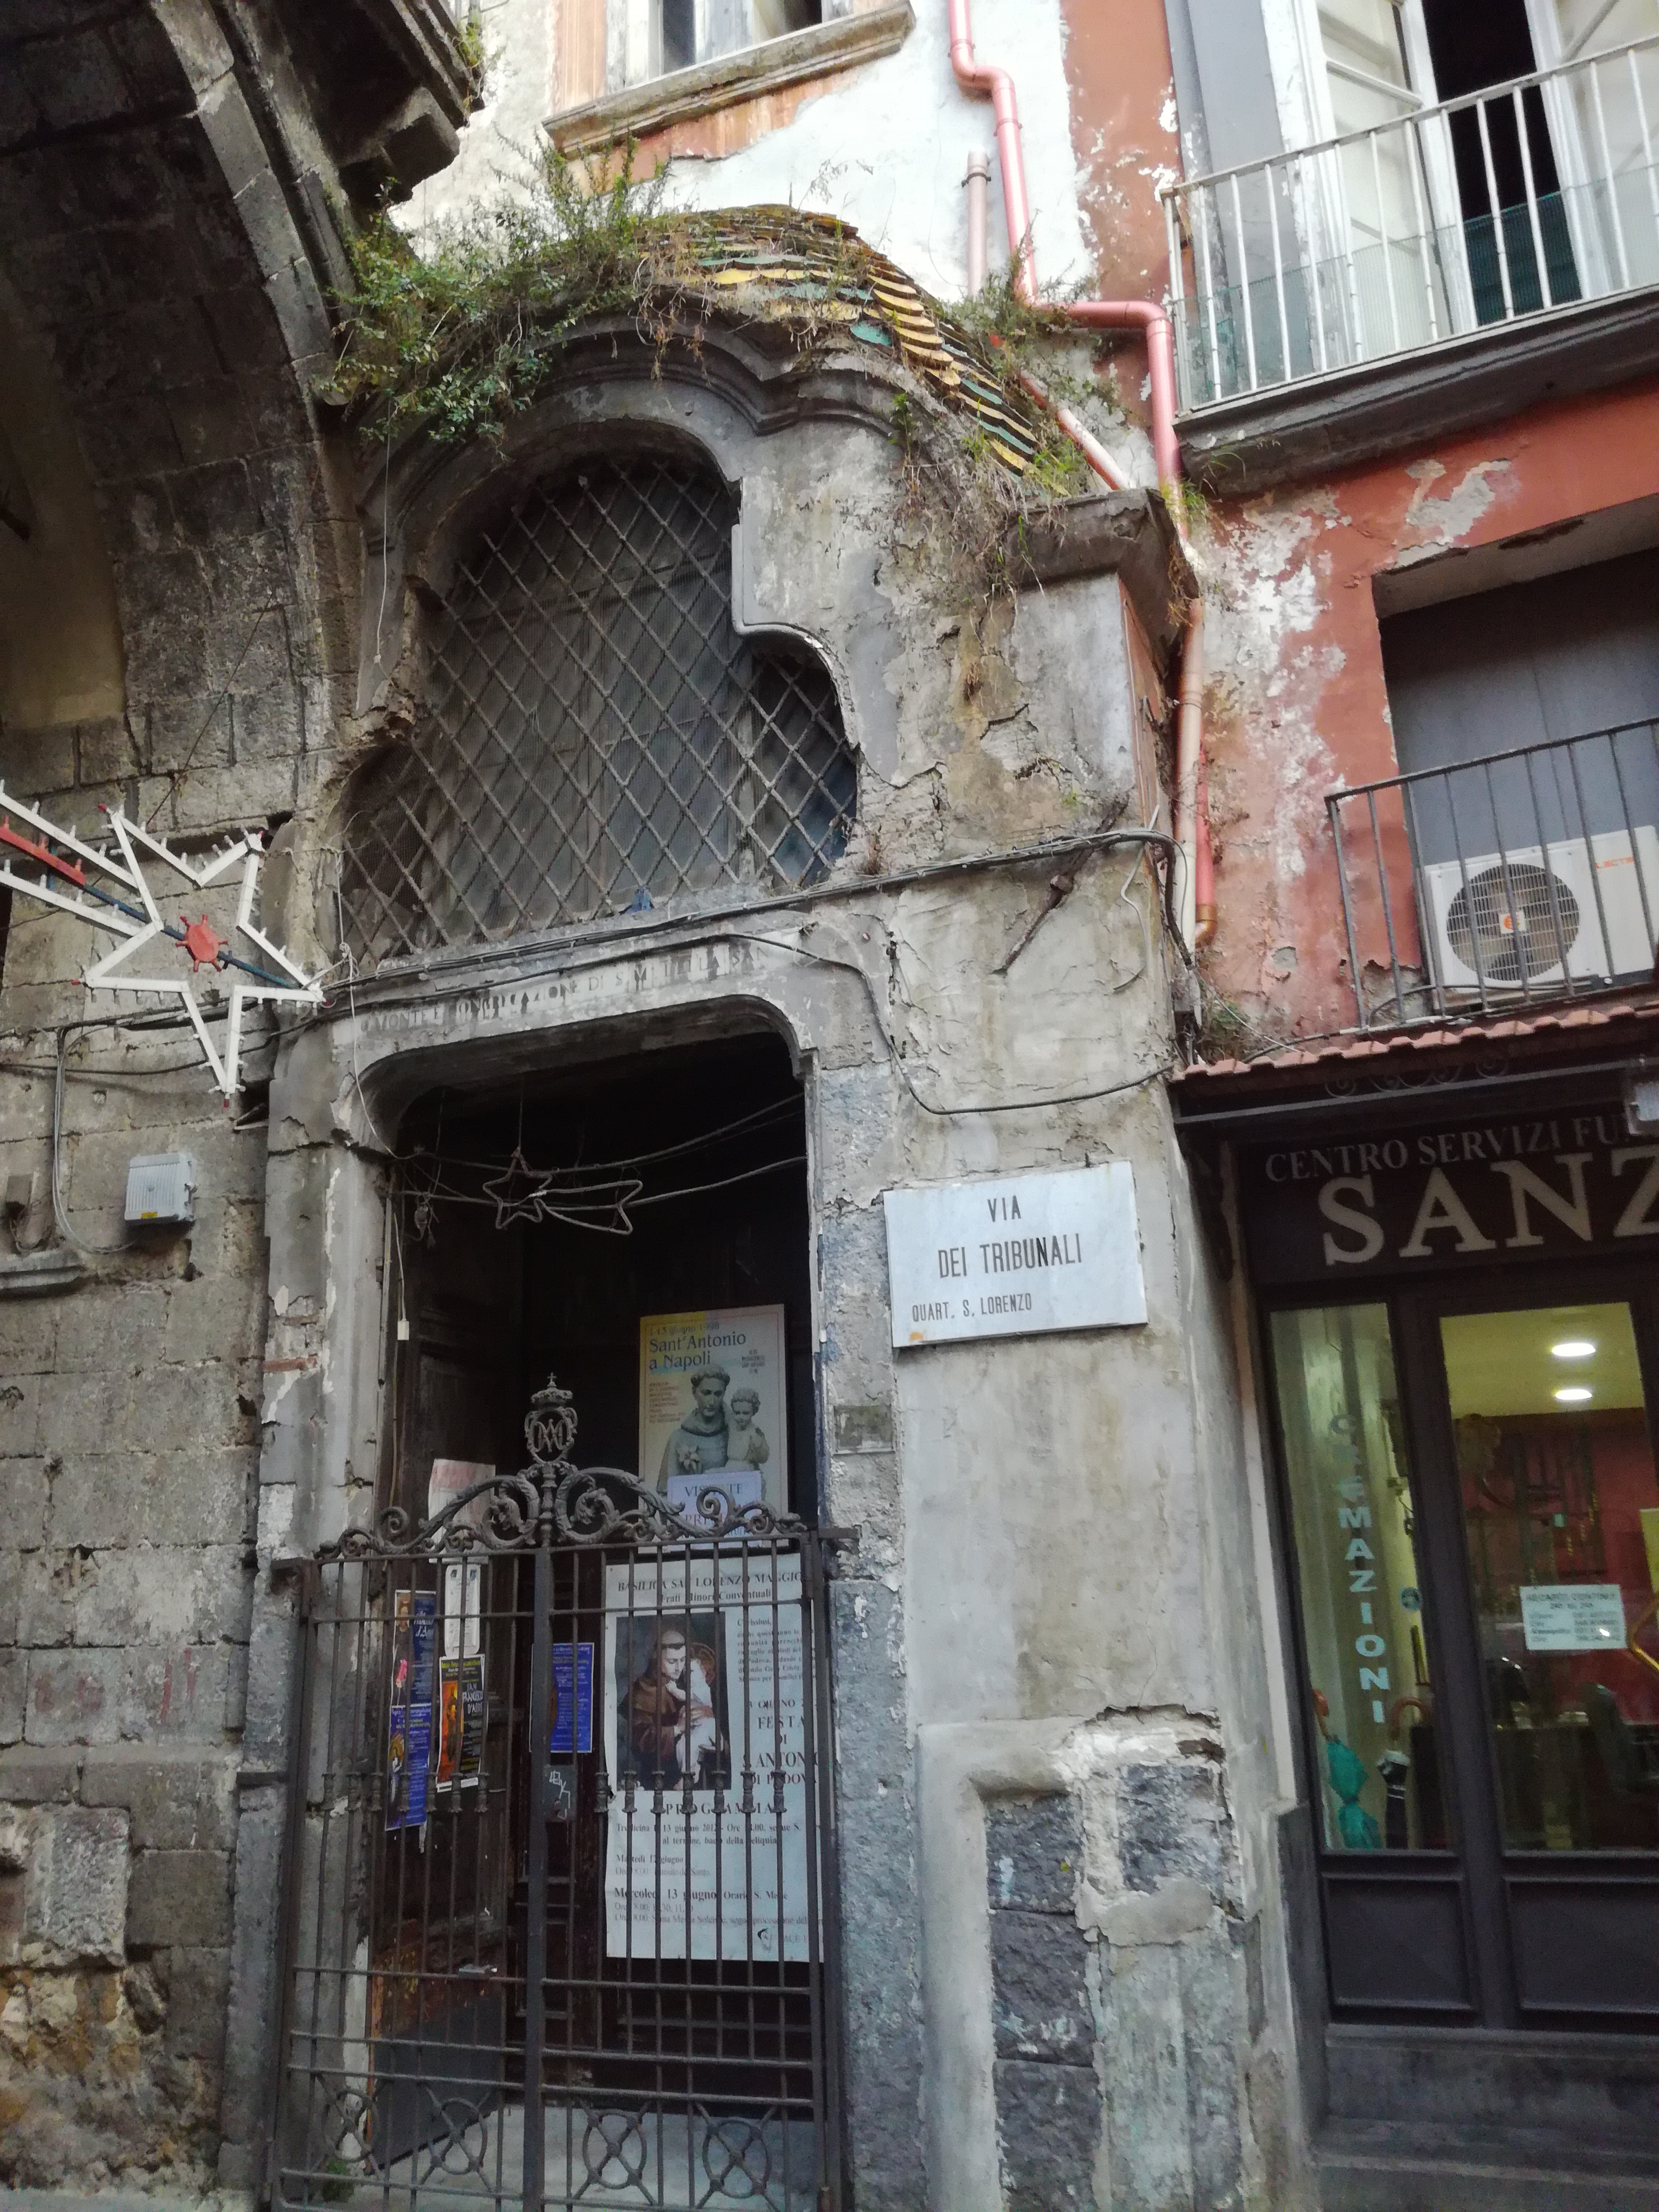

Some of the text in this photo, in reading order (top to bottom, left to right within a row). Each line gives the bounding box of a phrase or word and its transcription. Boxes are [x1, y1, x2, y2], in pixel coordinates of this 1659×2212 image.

[1265, 1114, 1629, 1182] CENTRO SERVIZI FU
[987, 1195, 1021, 1222] VIA
[1318, 1144, 1659, 1267] SANZ
[937, 1233, 1083, 1278] DEI TRIBUNALI
[911, 1293, 1033, 1322] QUART. S. LORENZO
[649, 1330, 747, 1353] Sant'Antonio
[649, 1350, 711, 1371] a Napoli
[696, 1575, 751, 1587] LOENZO
[755, 1571, 801, 1584] MAGGIO
[661, 1593, 681, 1603] rati
[718, 1588, 772, 1600] Convntuali
[666, 1802, 777, 1815] PROGAMA
[617, 1823, 650, 1832] Treicina
[674, 1823, 699, 1833] giuno
[747, 1836, 777, 1847] eliquia
[667, 1888, 678, 1900] 13
[683, 1890, 718, 1902] gugno
[723, 1891, 748, 1899] Orari
[765, 1890, 788, 1900] Mee
